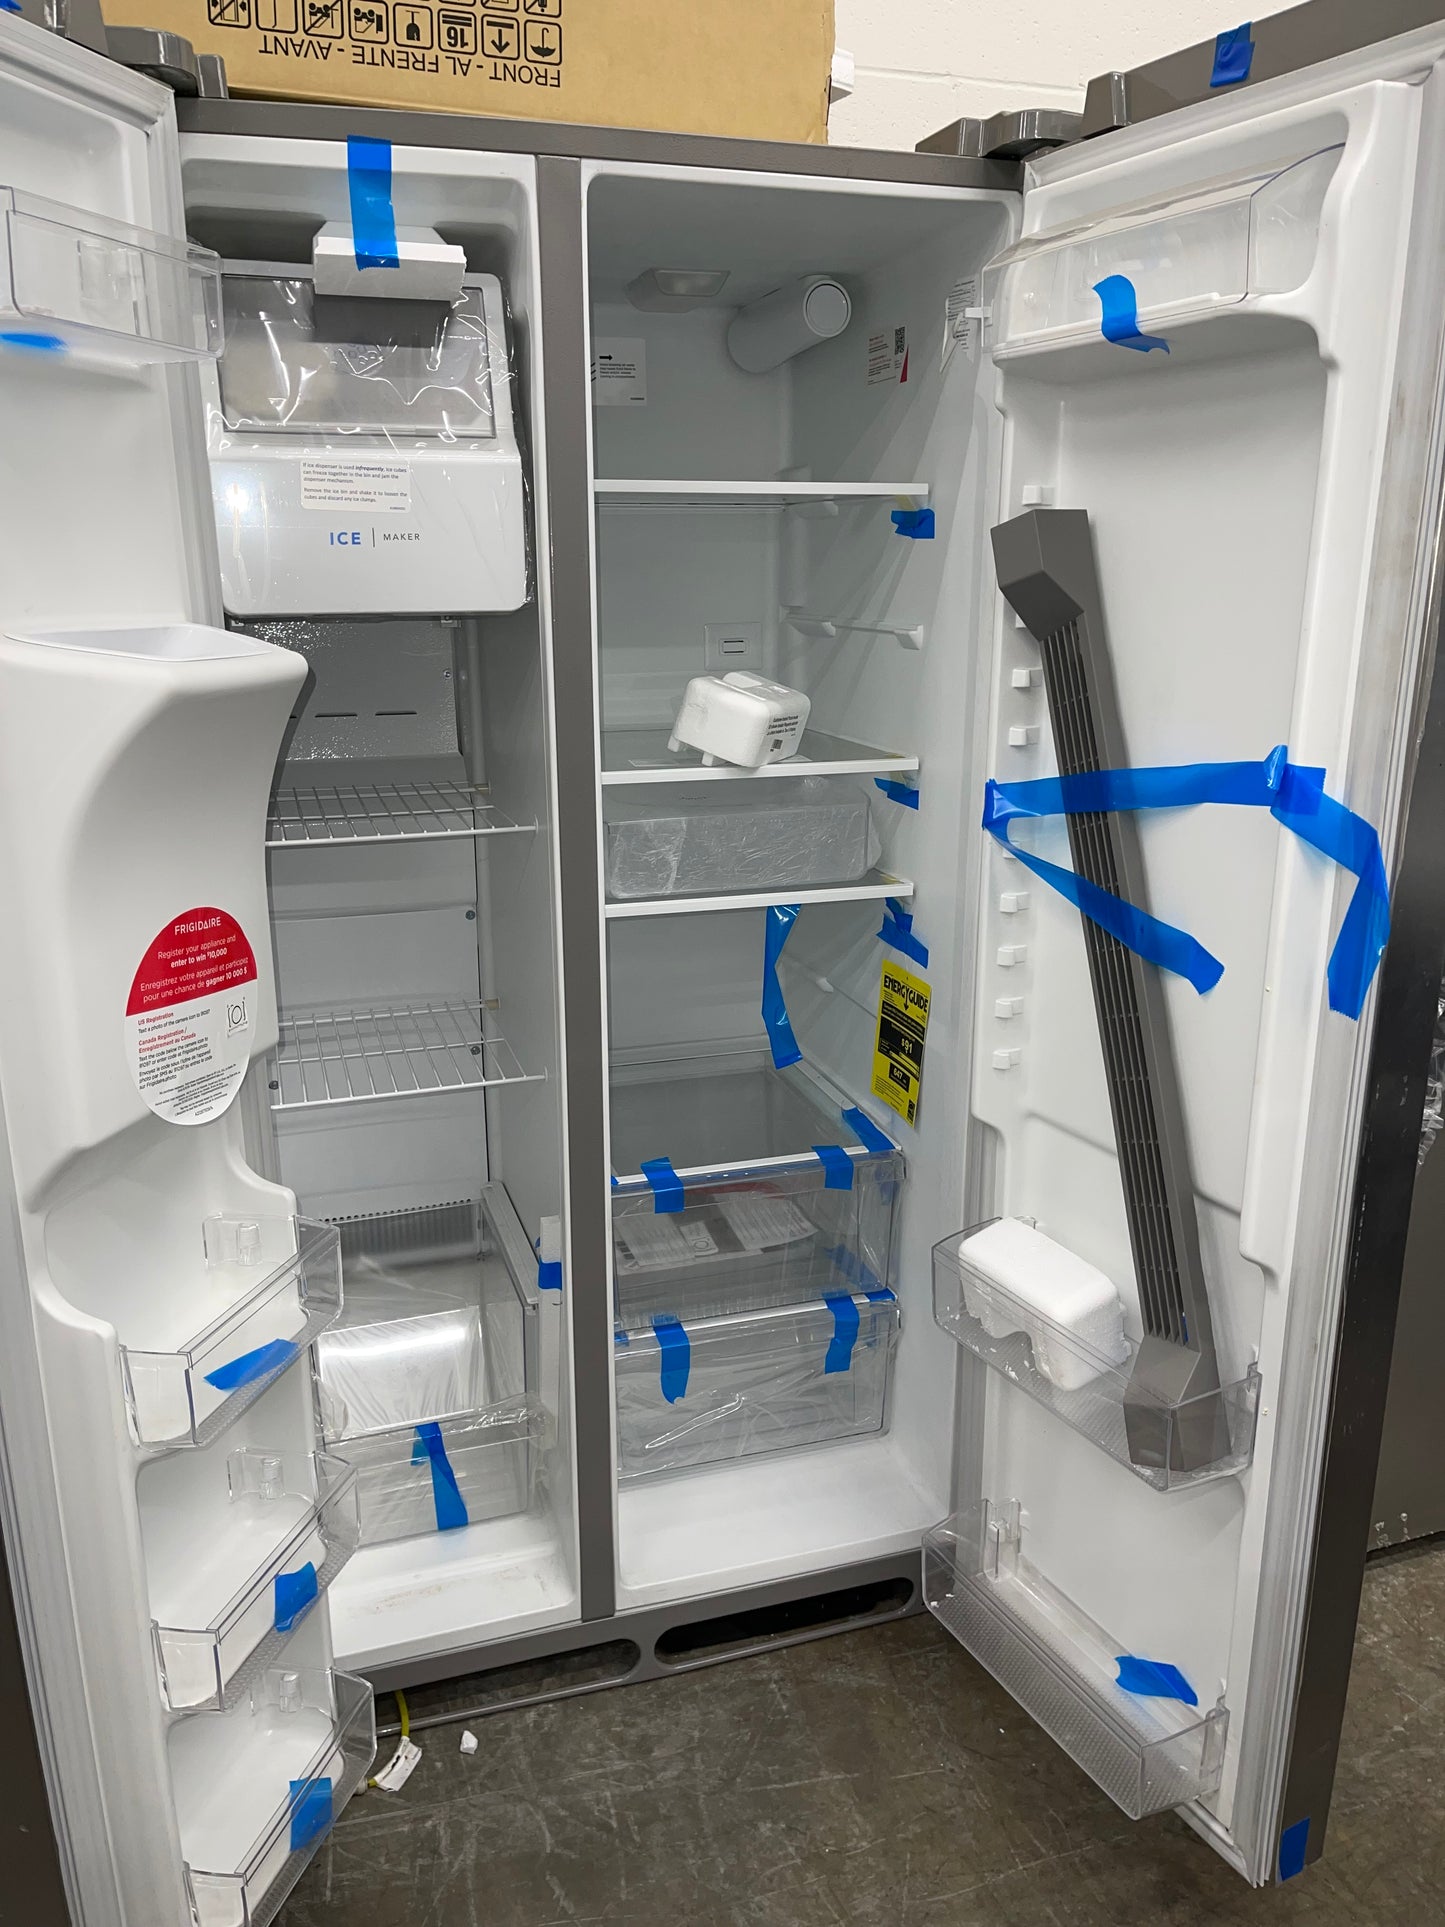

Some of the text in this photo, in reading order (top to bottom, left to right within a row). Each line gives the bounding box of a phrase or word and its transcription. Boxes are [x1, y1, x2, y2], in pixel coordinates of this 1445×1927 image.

[259, 34, 332, 60] AVANT
[352, 44, 439, 73] FRENTE
[445, 55, 471, 76] AL
[489, 62, 561, 88] FRONT
[330, 532, 361, 545] ICE
[175, 917, 221, 935] FRIGIDAIRE
[158, 934, 236, 960] Register your appliance and
[171, 959, 187, 968] enter
[196, 954, 206, 962] win
[141, 976, 177, 991] Enregistrez
[179, 972, 194, 982] votre
[196, 966, 218, 978] appareil
[226, 957, 248, 970] participez
[143, 994, 159, 1004] pour
[161, 989, 173, 998] une
[175, 983, 195, 995] chance
[206, 974, 224, 987] gagner
[233, 968, 243, 977] 000
[146, 1012, 174, 1023] Registration
[139, 1037, 156, 1046] Canada
[158, 1029, 184, 1040] Registration
